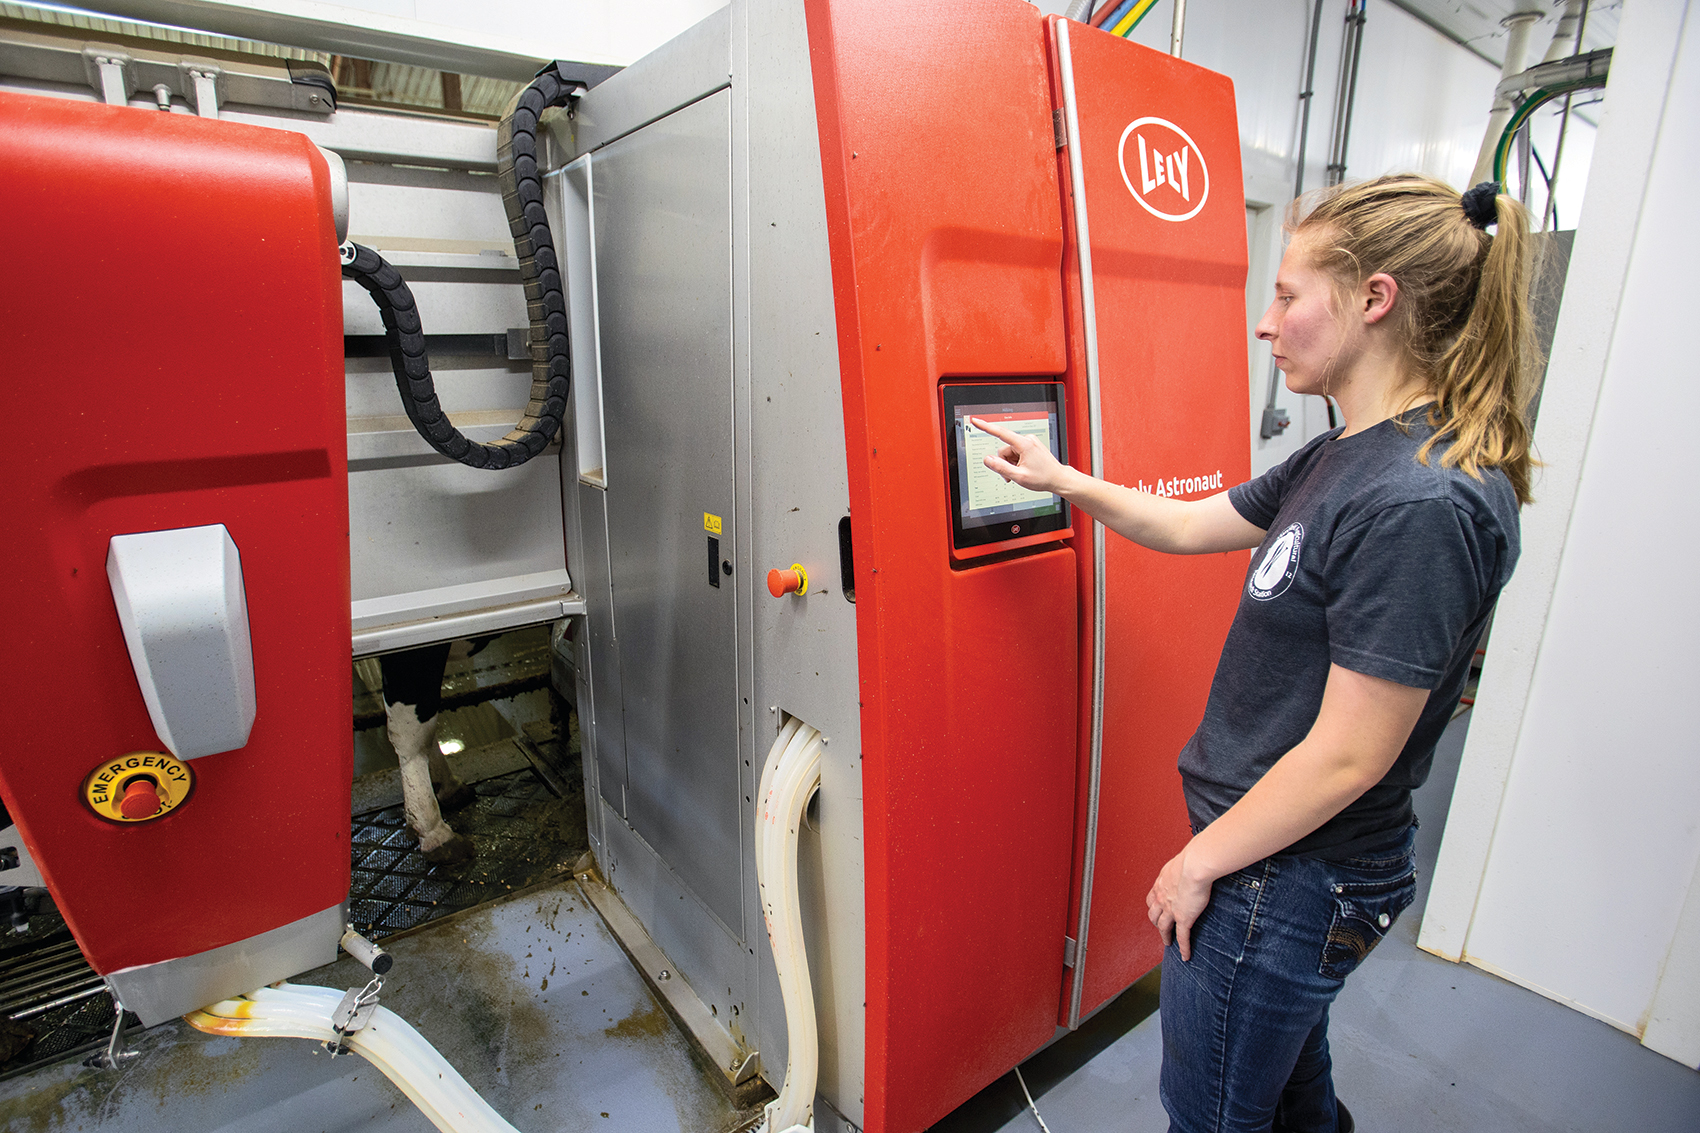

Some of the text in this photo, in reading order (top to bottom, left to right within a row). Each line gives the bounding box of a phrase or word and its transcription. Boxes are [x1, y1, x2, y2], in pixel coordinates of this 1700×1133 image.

[1137, 133, 1190, 202] LELY
[1156, 469, 1223, 498] Astronaut
[92, 756, 187, 804] EMERGENCY
